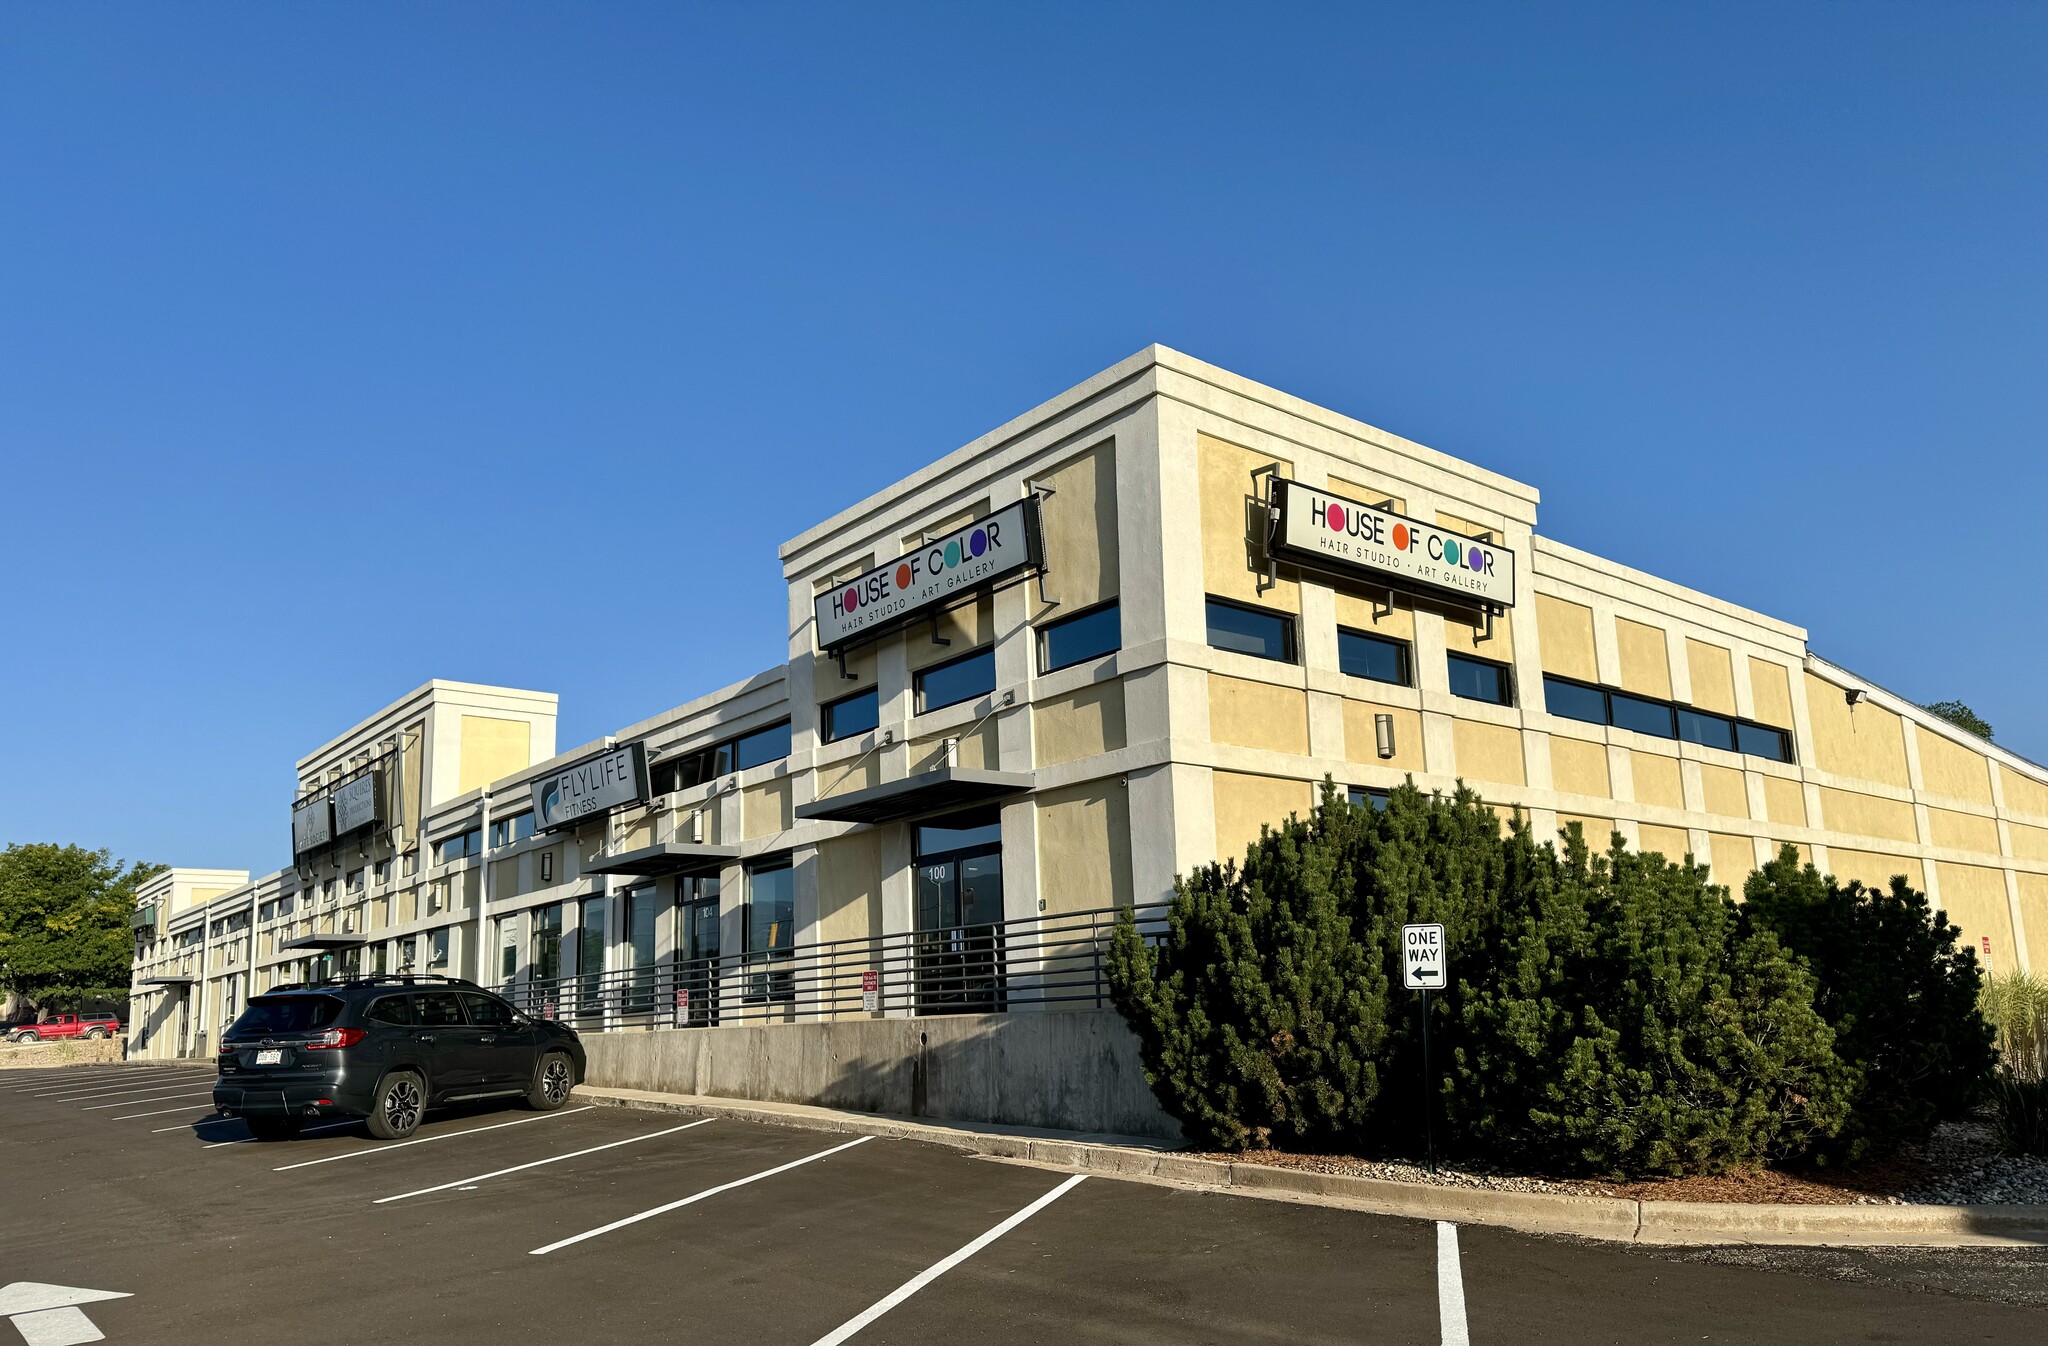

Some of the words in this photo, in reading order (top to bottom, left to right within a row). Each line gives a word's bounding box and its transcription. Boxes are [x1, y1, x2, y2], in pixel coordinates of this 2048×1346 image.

[1311, 497, 1385, 545] HOUSE
[1392, 522, 1420, 554] OF
[1427, 534, 1495, 578] COLOR
[832, 571, 890, 620] HOUSE
[895, 556, 921, 590] OF
[928, 521, 1003, 576] COLOR
[1320, 536, 1349, 555] HAIR
[1356, 547, 1400, 568] STUDIO
[1417, 564, 1437, 579] ART
[1443, 573, 1489, 593] GALLERY
[841, 616, 864, 633] HAIR
[868, 598, 906, 622] STUDIO
[921, 583, 940, 600] ART
[947, 559, 996, 588] GALLERY
[561, 754, 628, 801] FLYLIFE
[348, 778, 372, 802] SQUIRES
[565, 796, 597, 819] FITNESS
[928, 865, 946, 881] 100
[702, 905, 713, 918] 104
[1408, 931, 1438, 945] ONE
[1408, 948, 1438, 962] WAY
